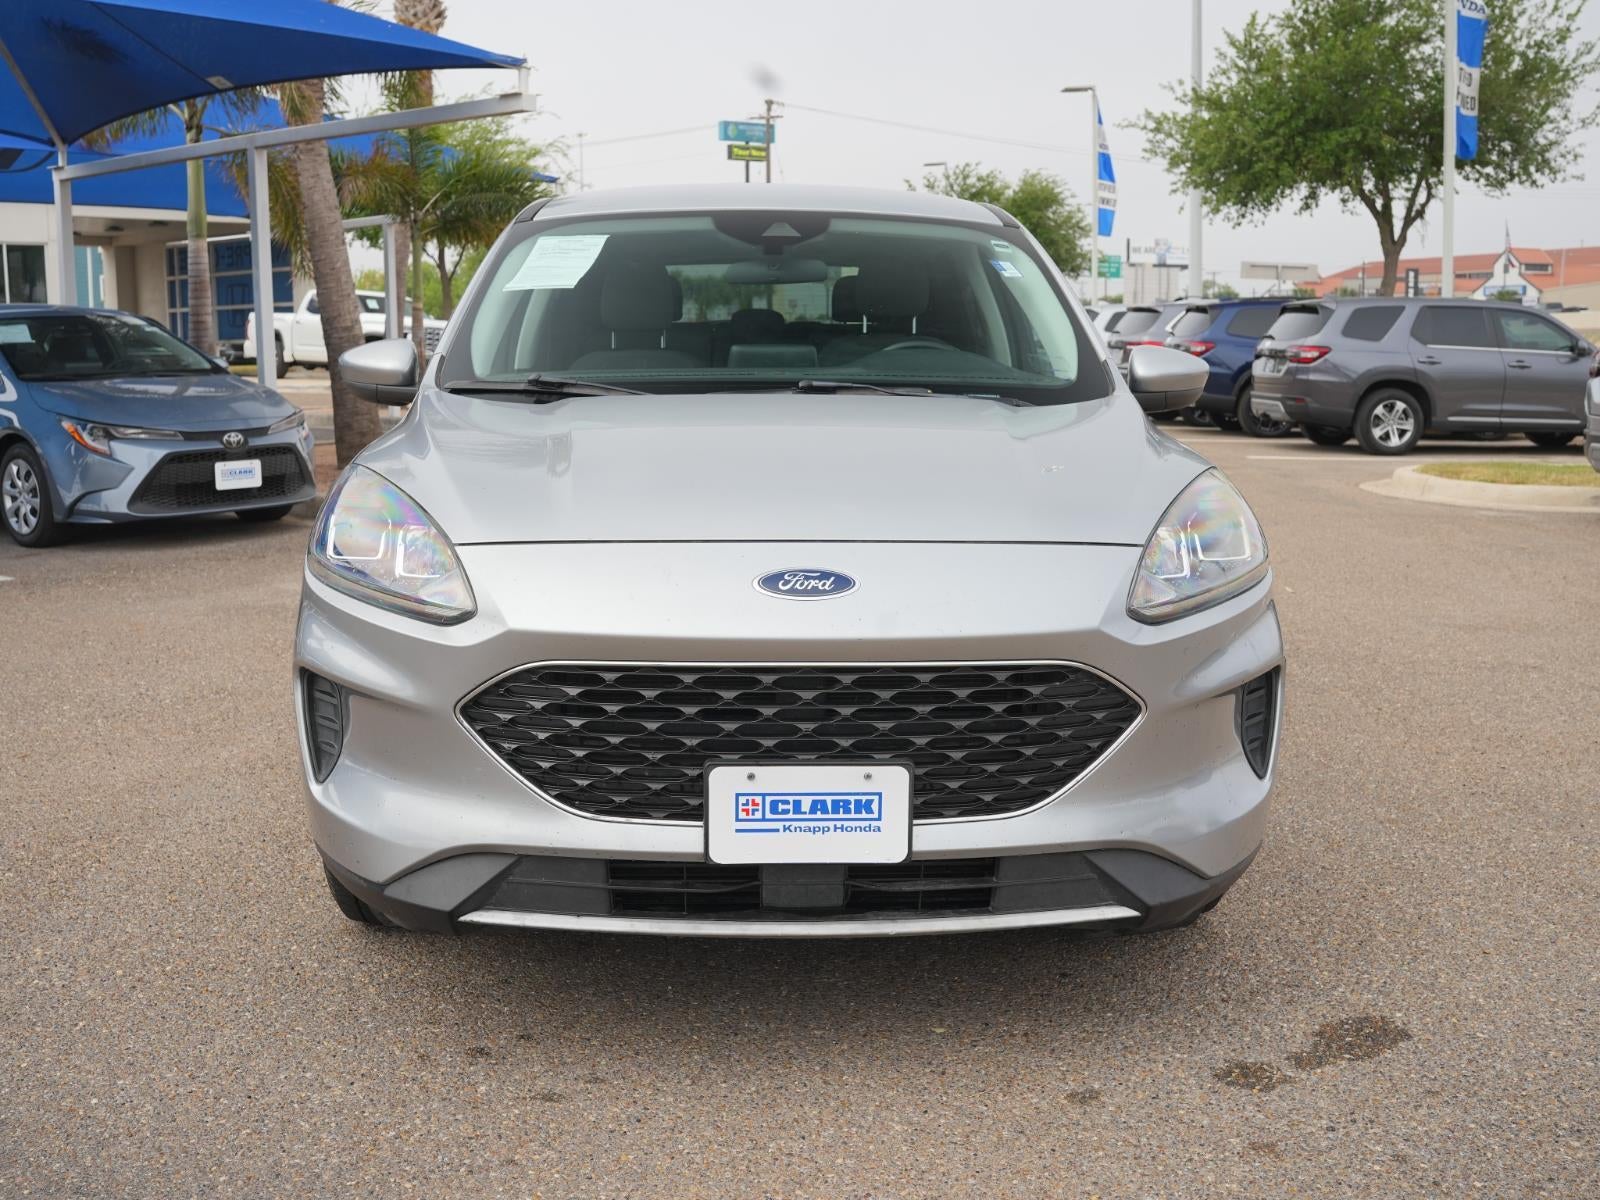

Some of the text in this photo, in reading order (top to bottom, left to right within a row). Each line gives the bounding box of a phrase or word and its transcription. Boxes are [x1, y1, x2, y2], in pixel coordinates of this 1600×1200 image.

[778, 571, 835, 591] Ford
[769, 799, 875, 816] CLARK
[782, 823, 882, 835] Knapp Honda
